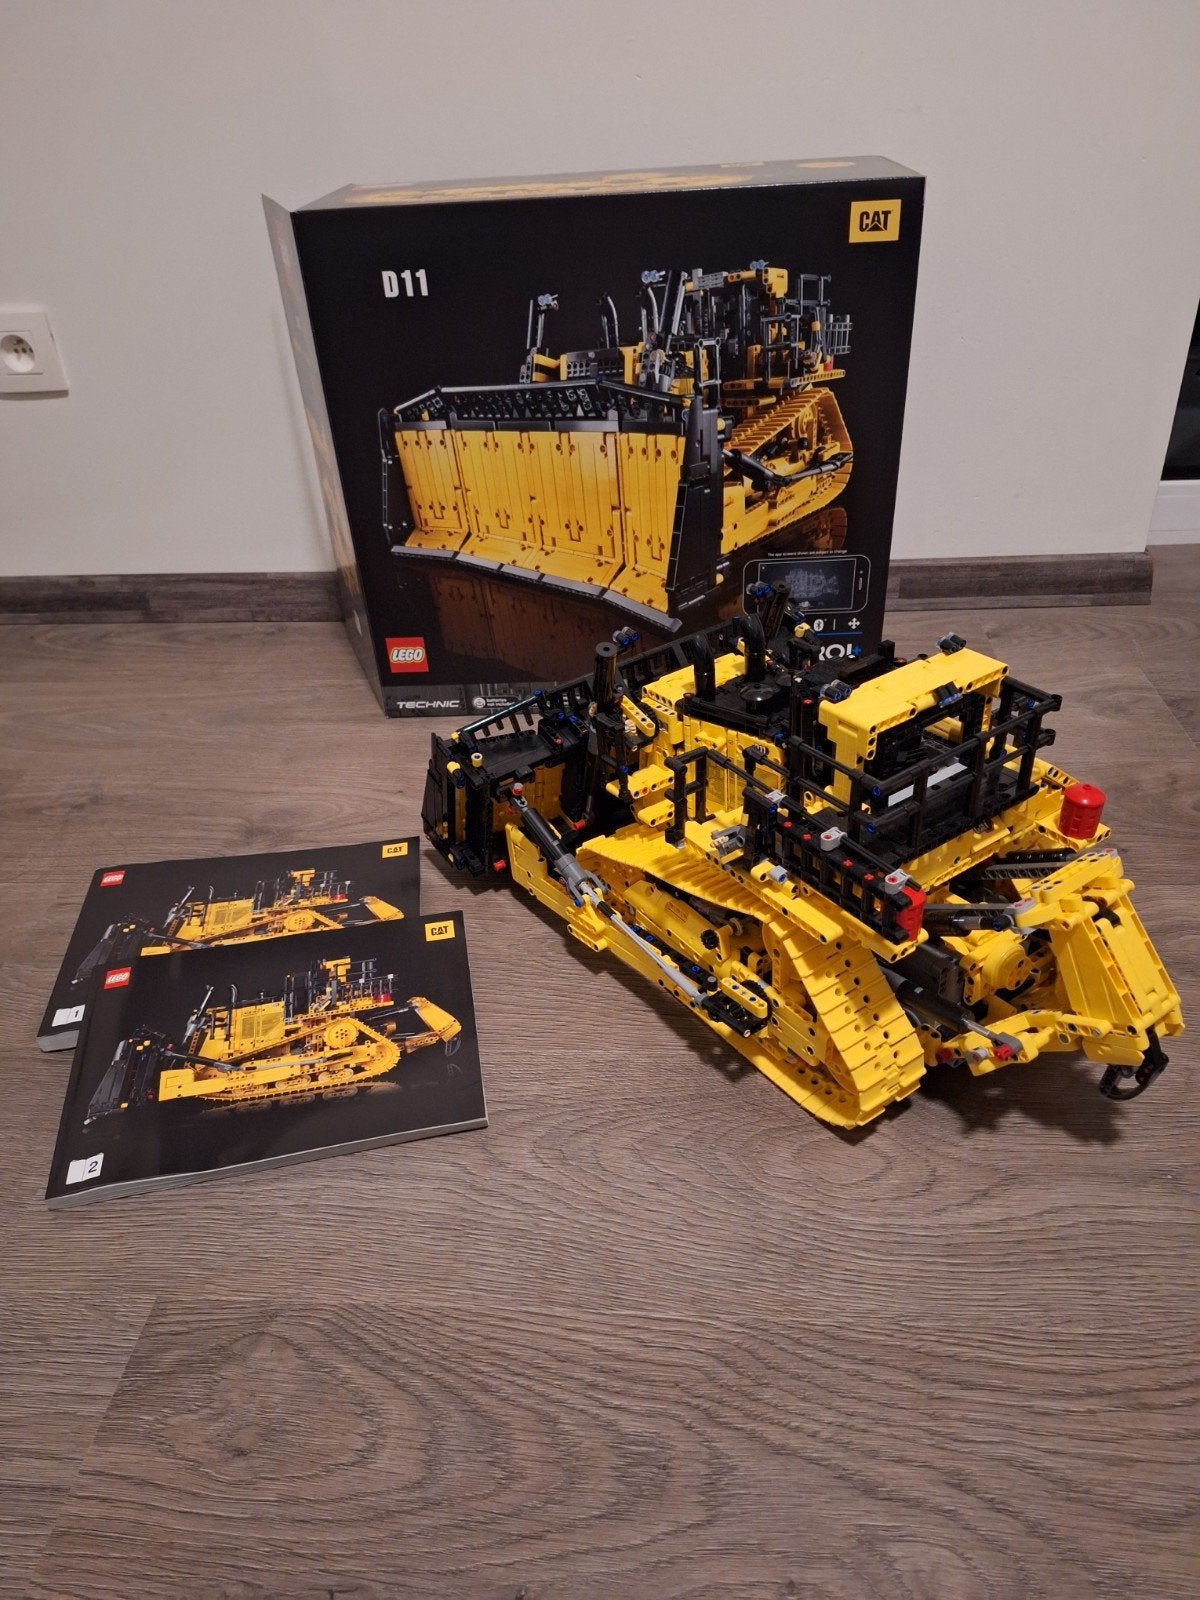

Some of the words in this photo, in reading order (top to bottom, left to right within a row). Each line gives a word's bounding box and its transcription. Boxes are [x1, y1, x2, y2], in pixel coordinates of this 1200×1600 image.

[859, 210, 892, 232] CAT
[381, 269, 429, 298] D11
[391, 648, 424, 662] LEGO
[396, 700, 460, 709] TECHNIC
[386, 846, 403, 854] CAT
[103, 874, 124, 883] LEGO
[430, 925, 449, 936] CAT
[106, 971, 130, 984] LEGO
[74, 1009, 80, 1018] 1
[88, 1161, 99, 1173] 2
